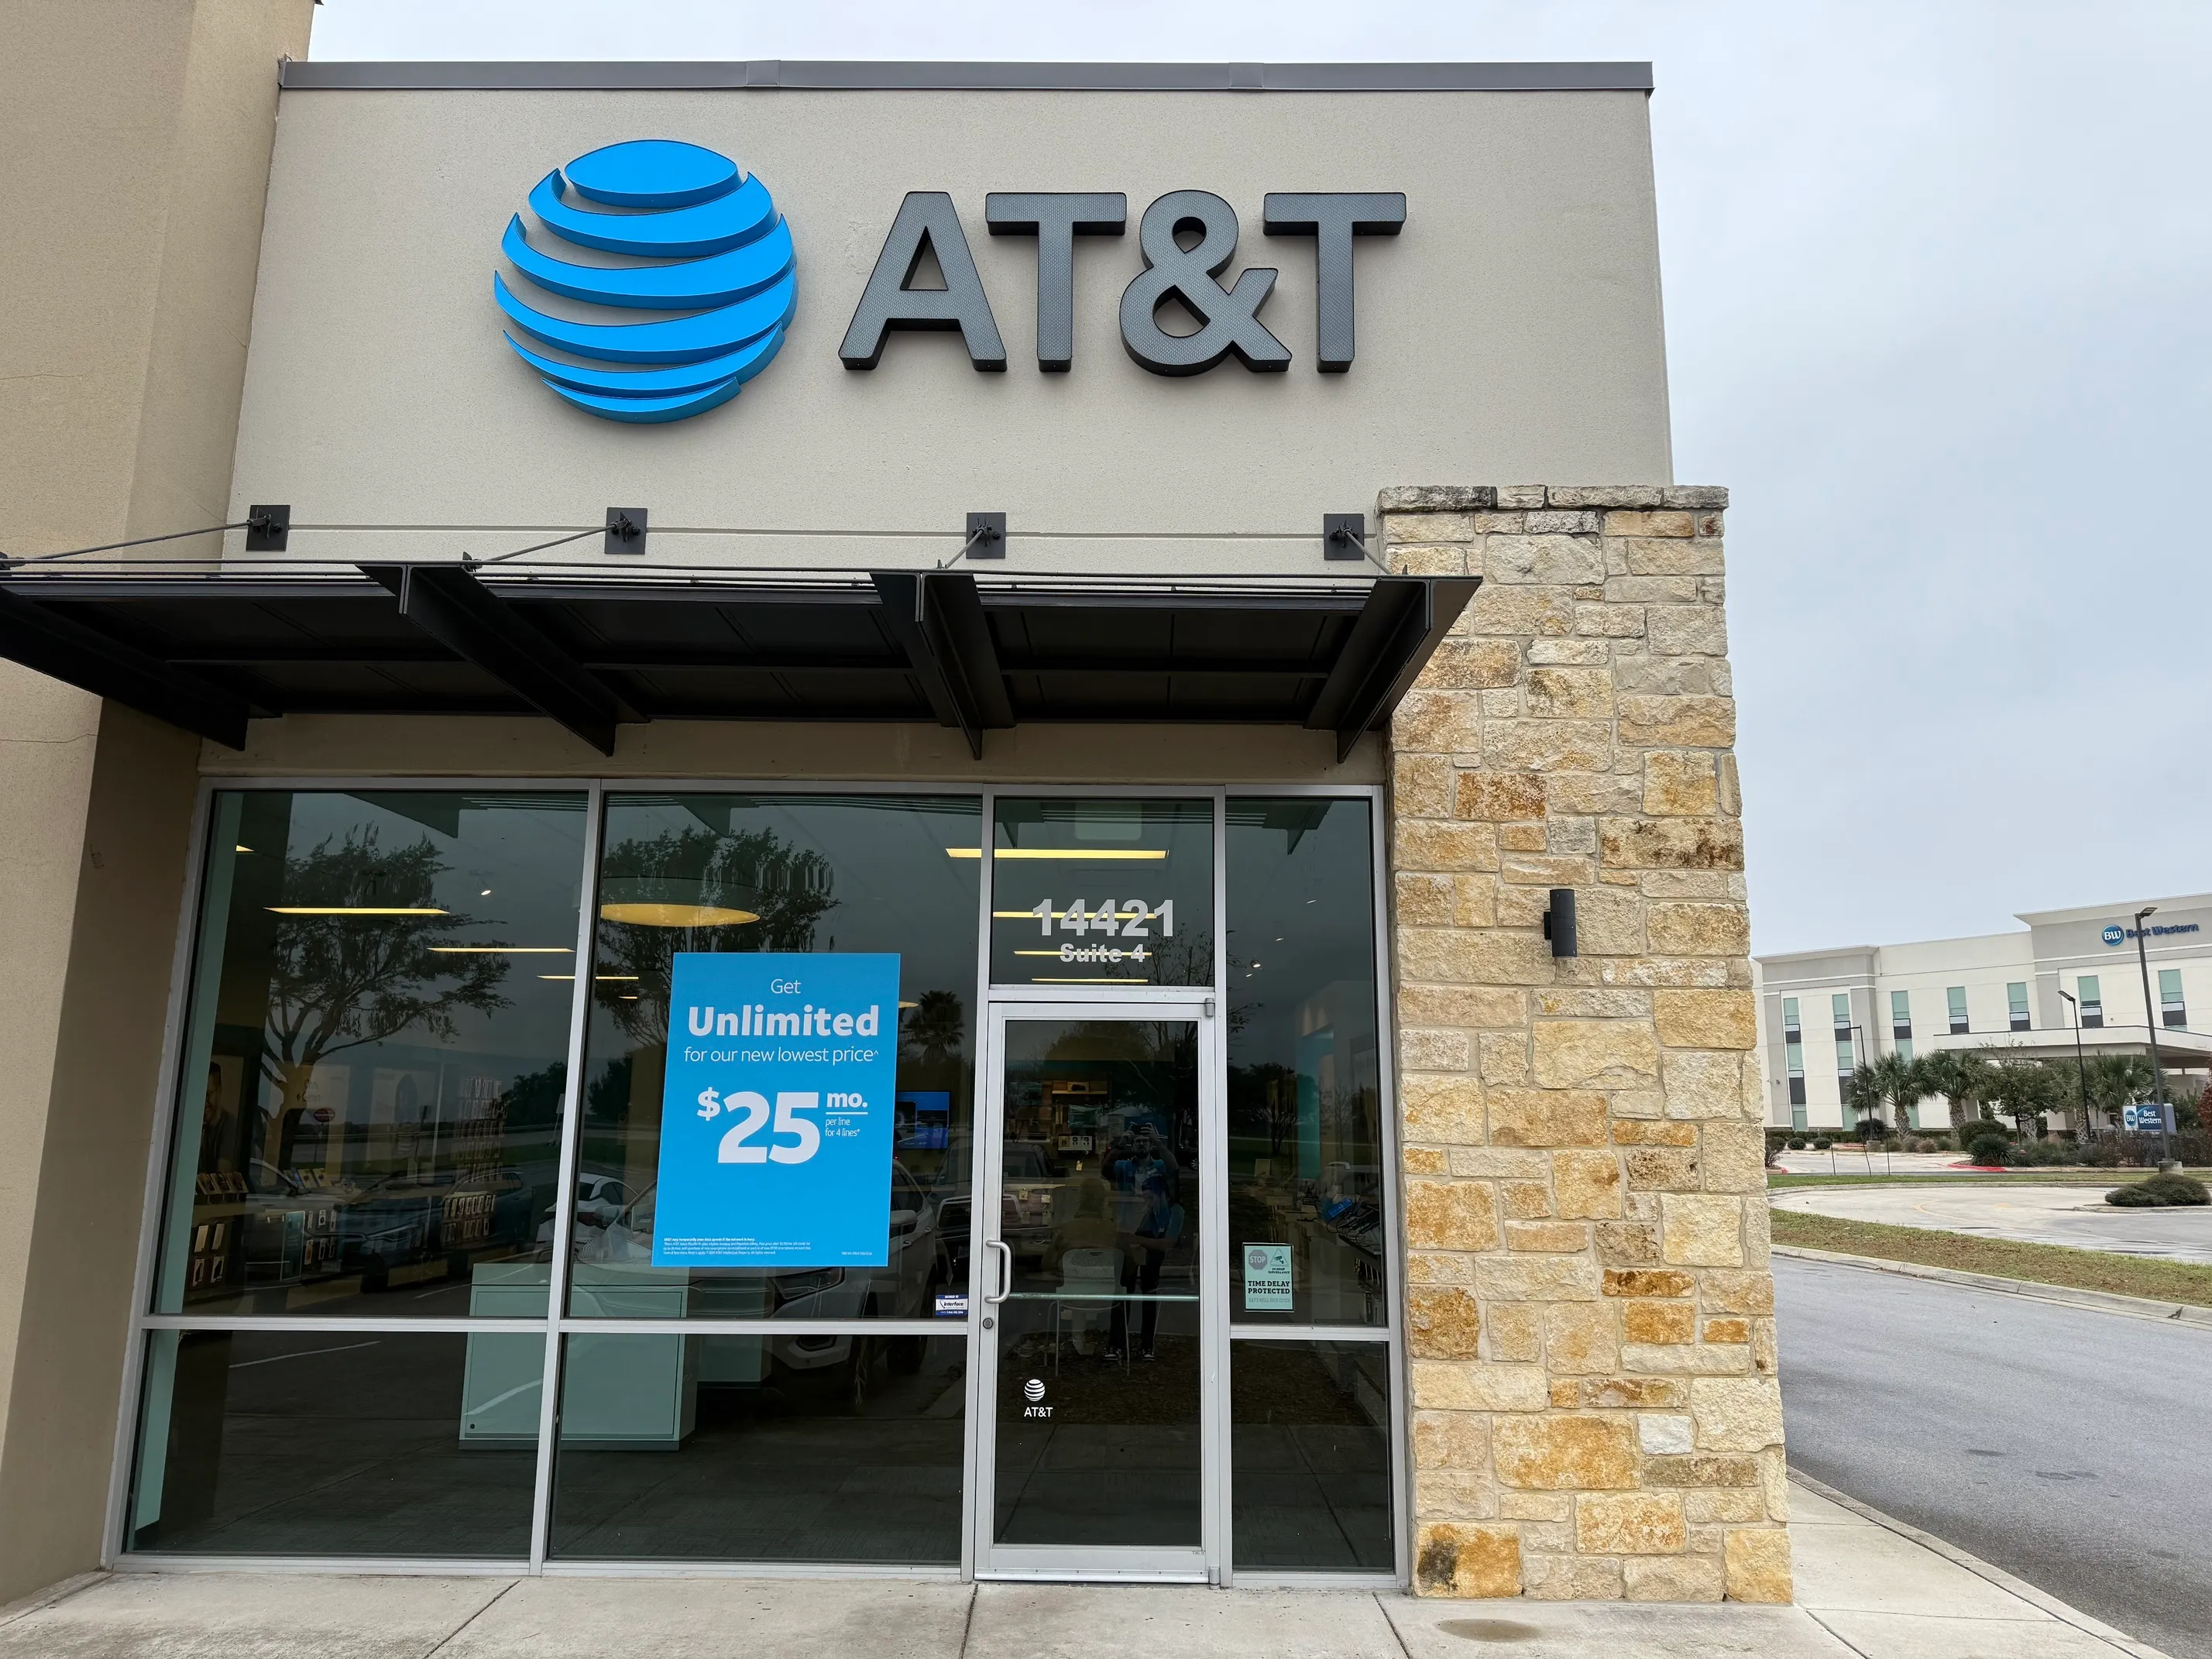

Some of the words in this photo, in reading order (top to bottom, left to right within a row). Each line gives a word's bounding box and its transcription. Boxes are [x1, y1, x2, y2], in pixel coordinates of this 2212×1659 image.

[838, 189, 1407, 376] AT&T
[1032, 898, 1173, 937] 14421
[2104, 930, 2121, 940] BW
[2152, 924, 2199, 936] Western
[1060, 943, 1123, 963] Suite
[1130, 943, 1146, 963] 4
[771, 978, 802, 994] Get
[688, 1004, 879, 1036] Unlimited
[684, 1046, 708, 1062] for
[710, 1050, 738, 1062] our
[741, 1050, 775, 1062] new
[778, 1046, 830, 1062] lowest
[697, 1087, 820, 1164] $25
[826, 1093, 868, 1108] mo.
[825, 1118, 837, 1128] per
[838, 1117, 850, 1125] line
[825, 1128, 836, 1137] for
[836, 1128, 840, 1137] 4
[1023, 1407, 1053, 1417] AT&T
